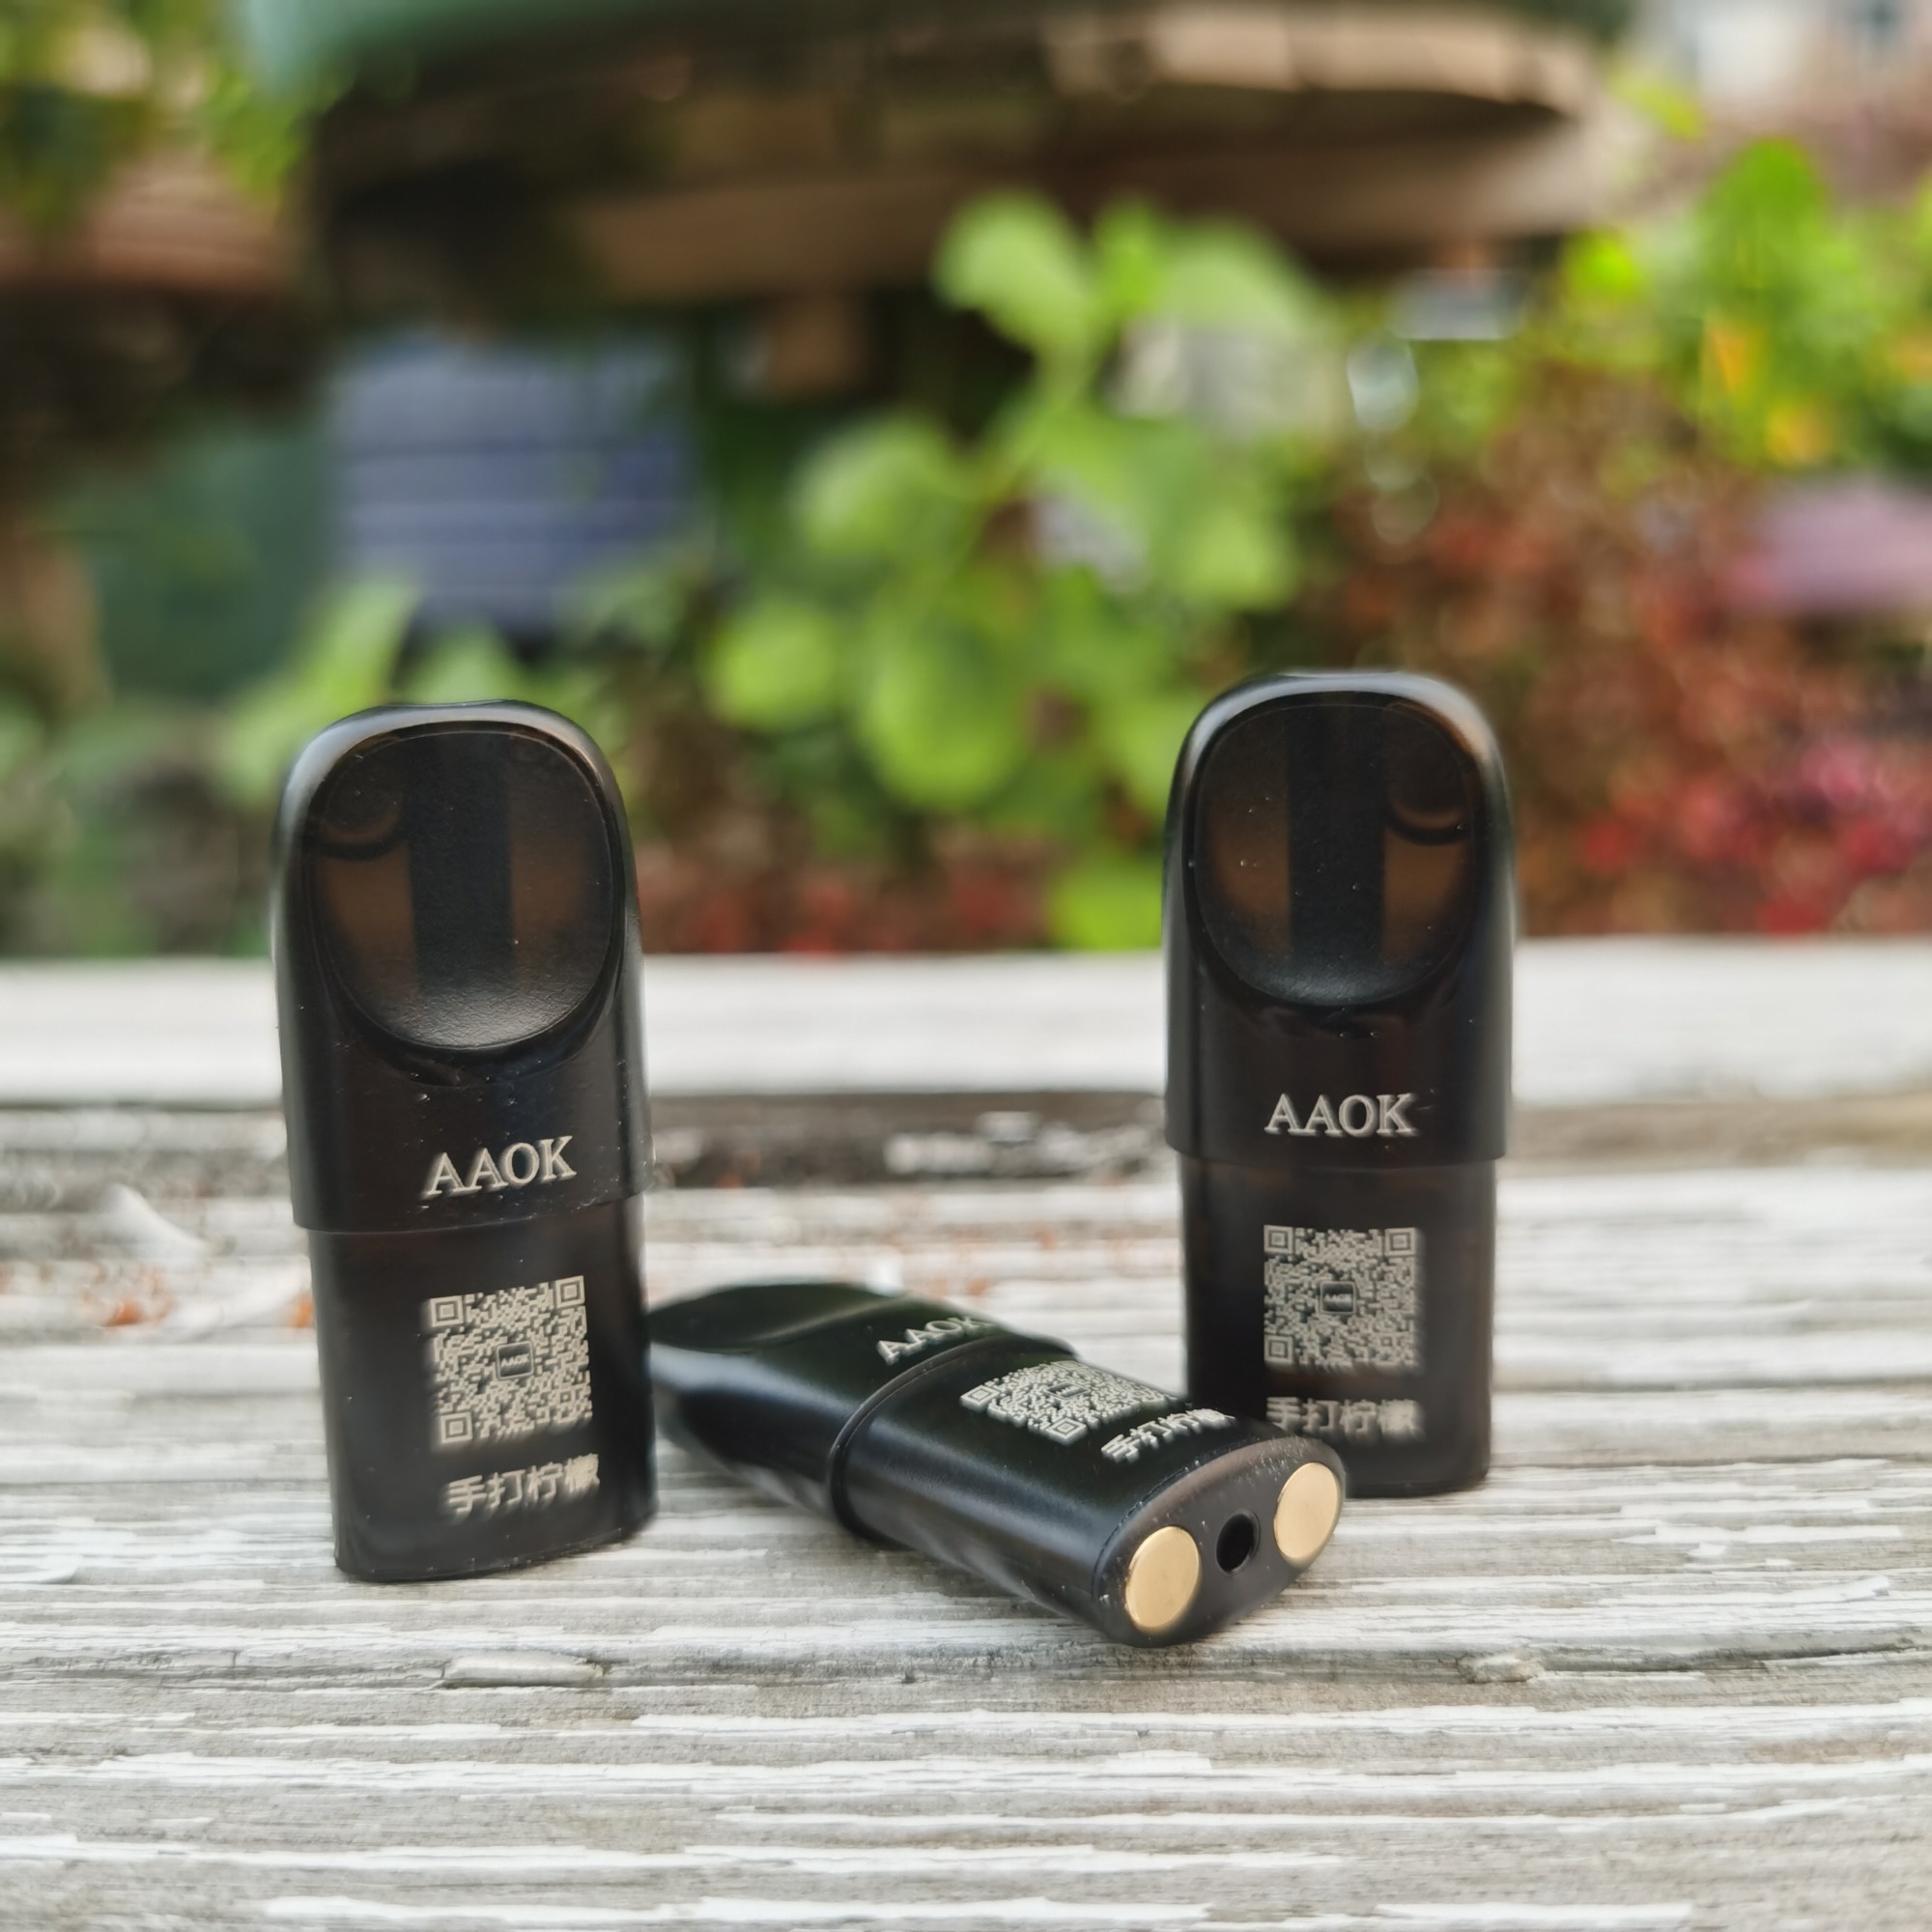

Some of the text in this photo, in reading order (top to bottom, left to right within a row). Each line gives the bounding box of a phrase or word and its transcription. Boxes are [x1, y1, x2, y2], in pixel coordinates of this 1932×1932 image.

[1264, 1093, 1416, 1137] AAOK
[423, 1135, 577, 1196] AAOK
[877, 1316, 997, 1363] AAOK
